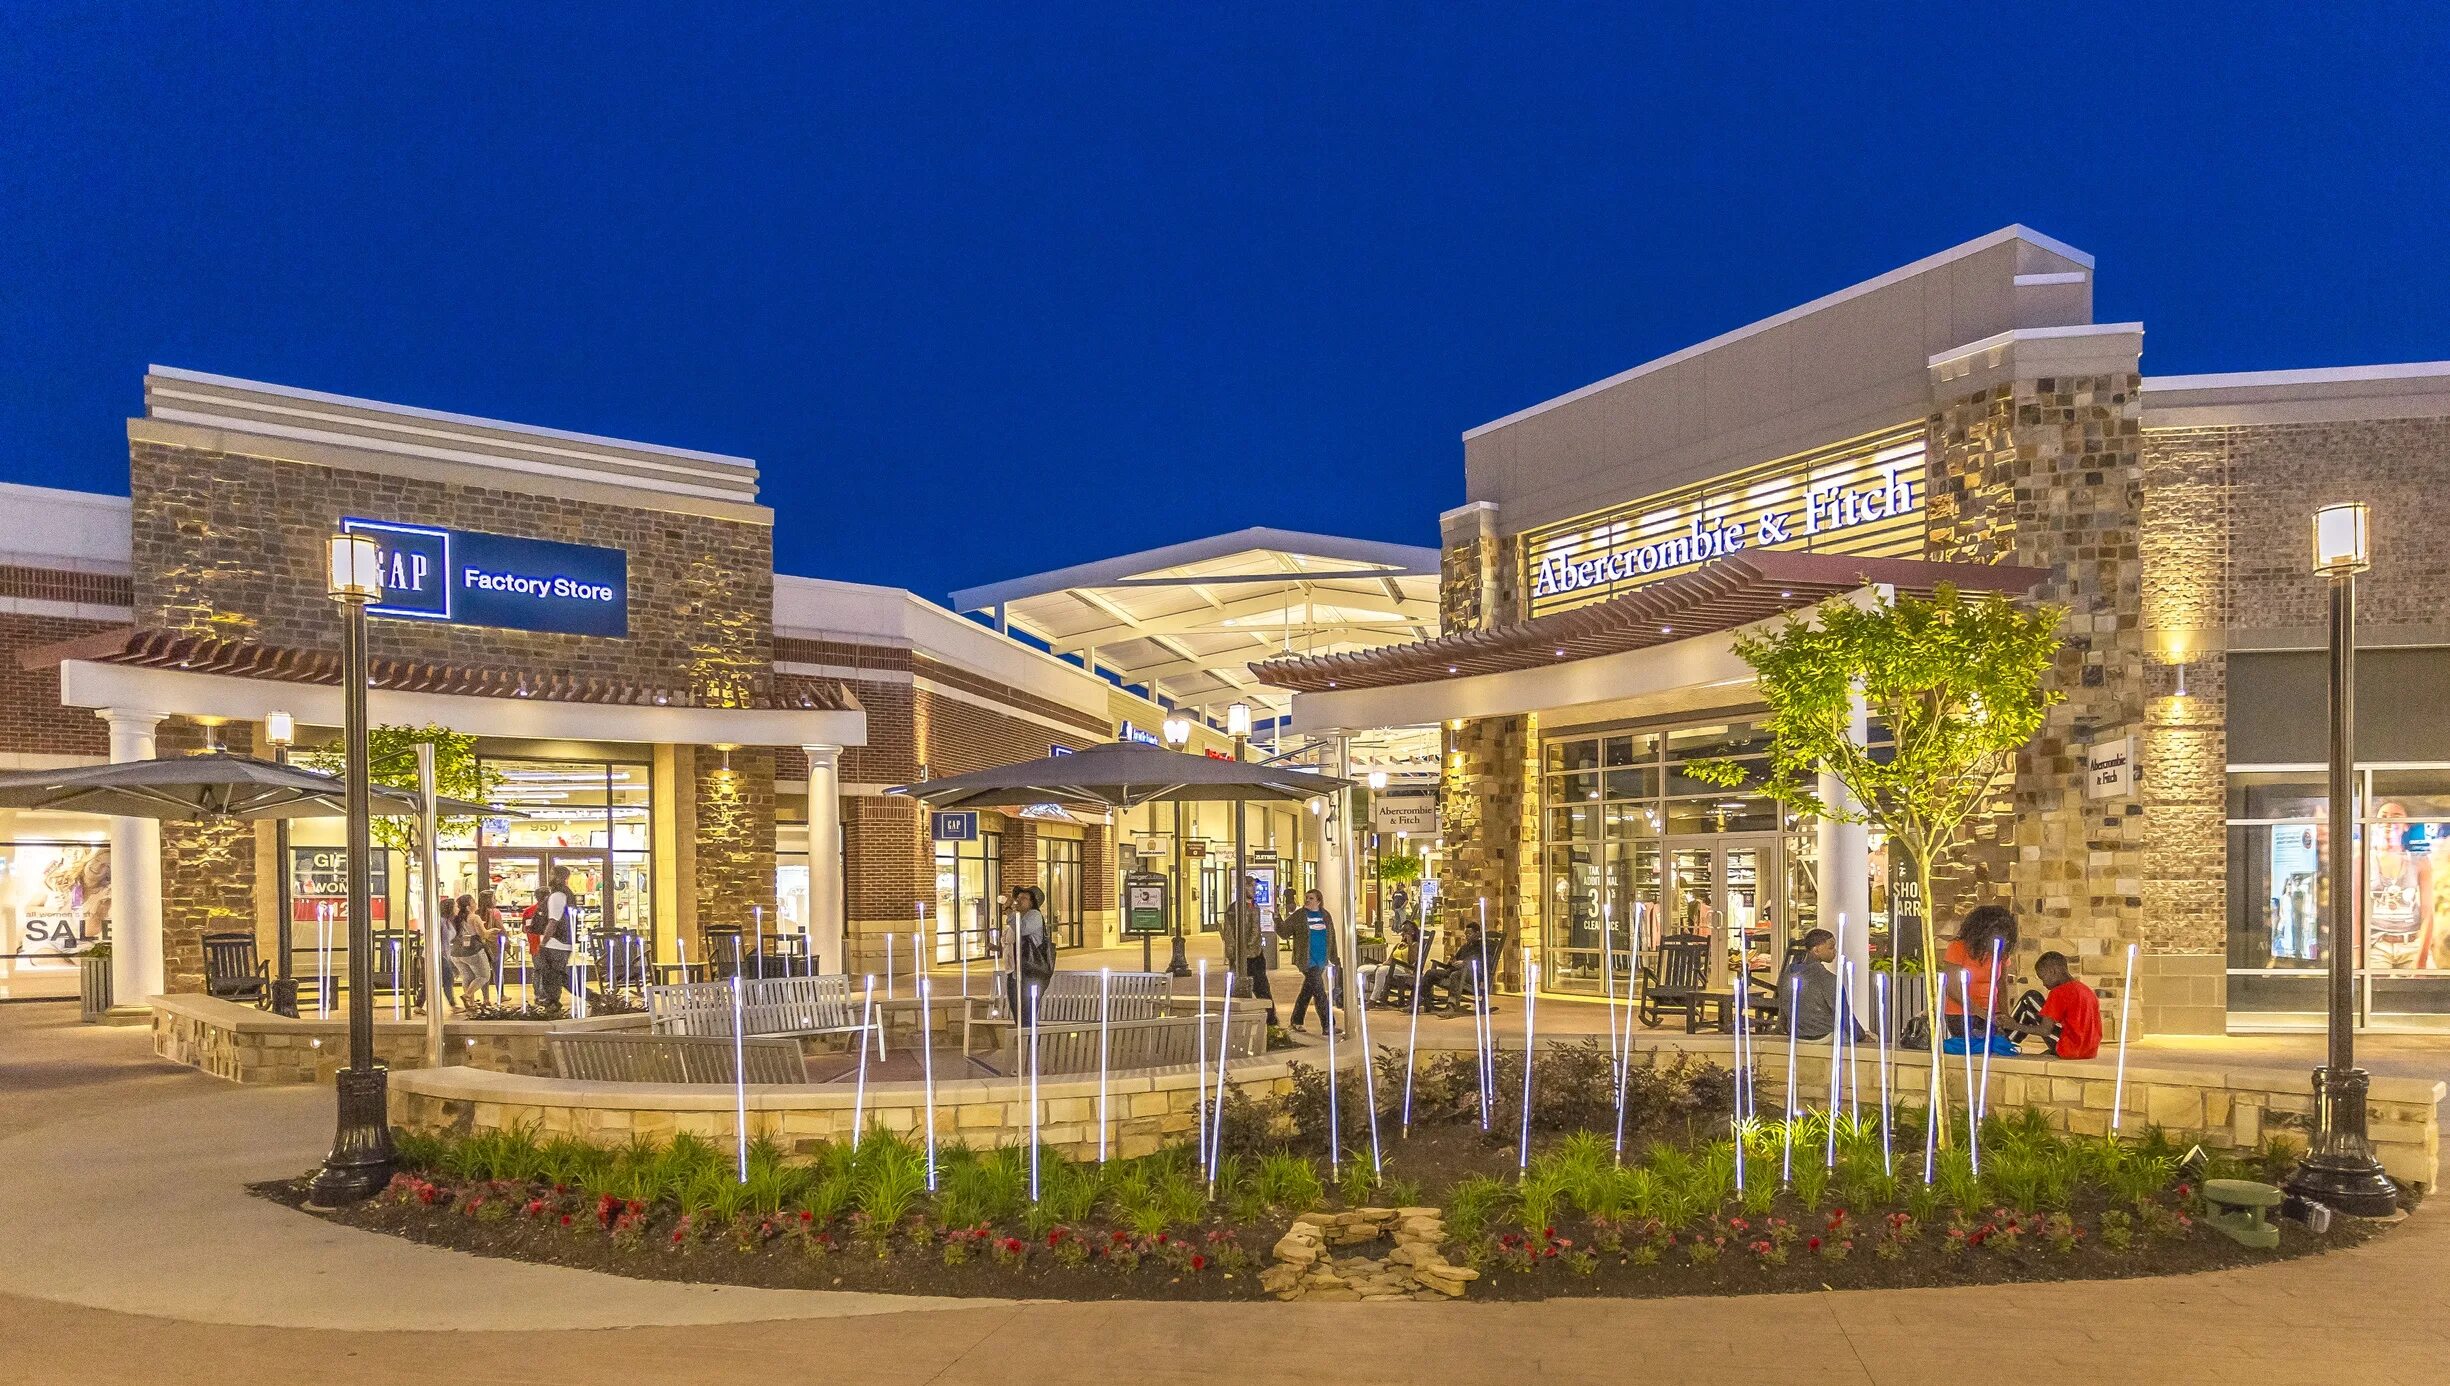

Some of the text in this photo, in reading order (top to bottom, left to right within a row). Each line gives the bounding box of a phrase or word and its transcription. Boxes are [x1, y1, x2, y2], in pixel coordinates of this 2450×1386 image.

[1534, 468, 1913, 598] Abercrombie & Fitch
[464, 569, 613, 602] Factory Store
[1379, 806, 1433, 816] Abercrombie
[947, 820, 961, 830] GAP
[1399, 816, 1420, 825] Fitch
[530, 823, 559, 832] 950
[1588, 865, 1602, 876] TAK
[1892, 881, 1921, 898] SHO
